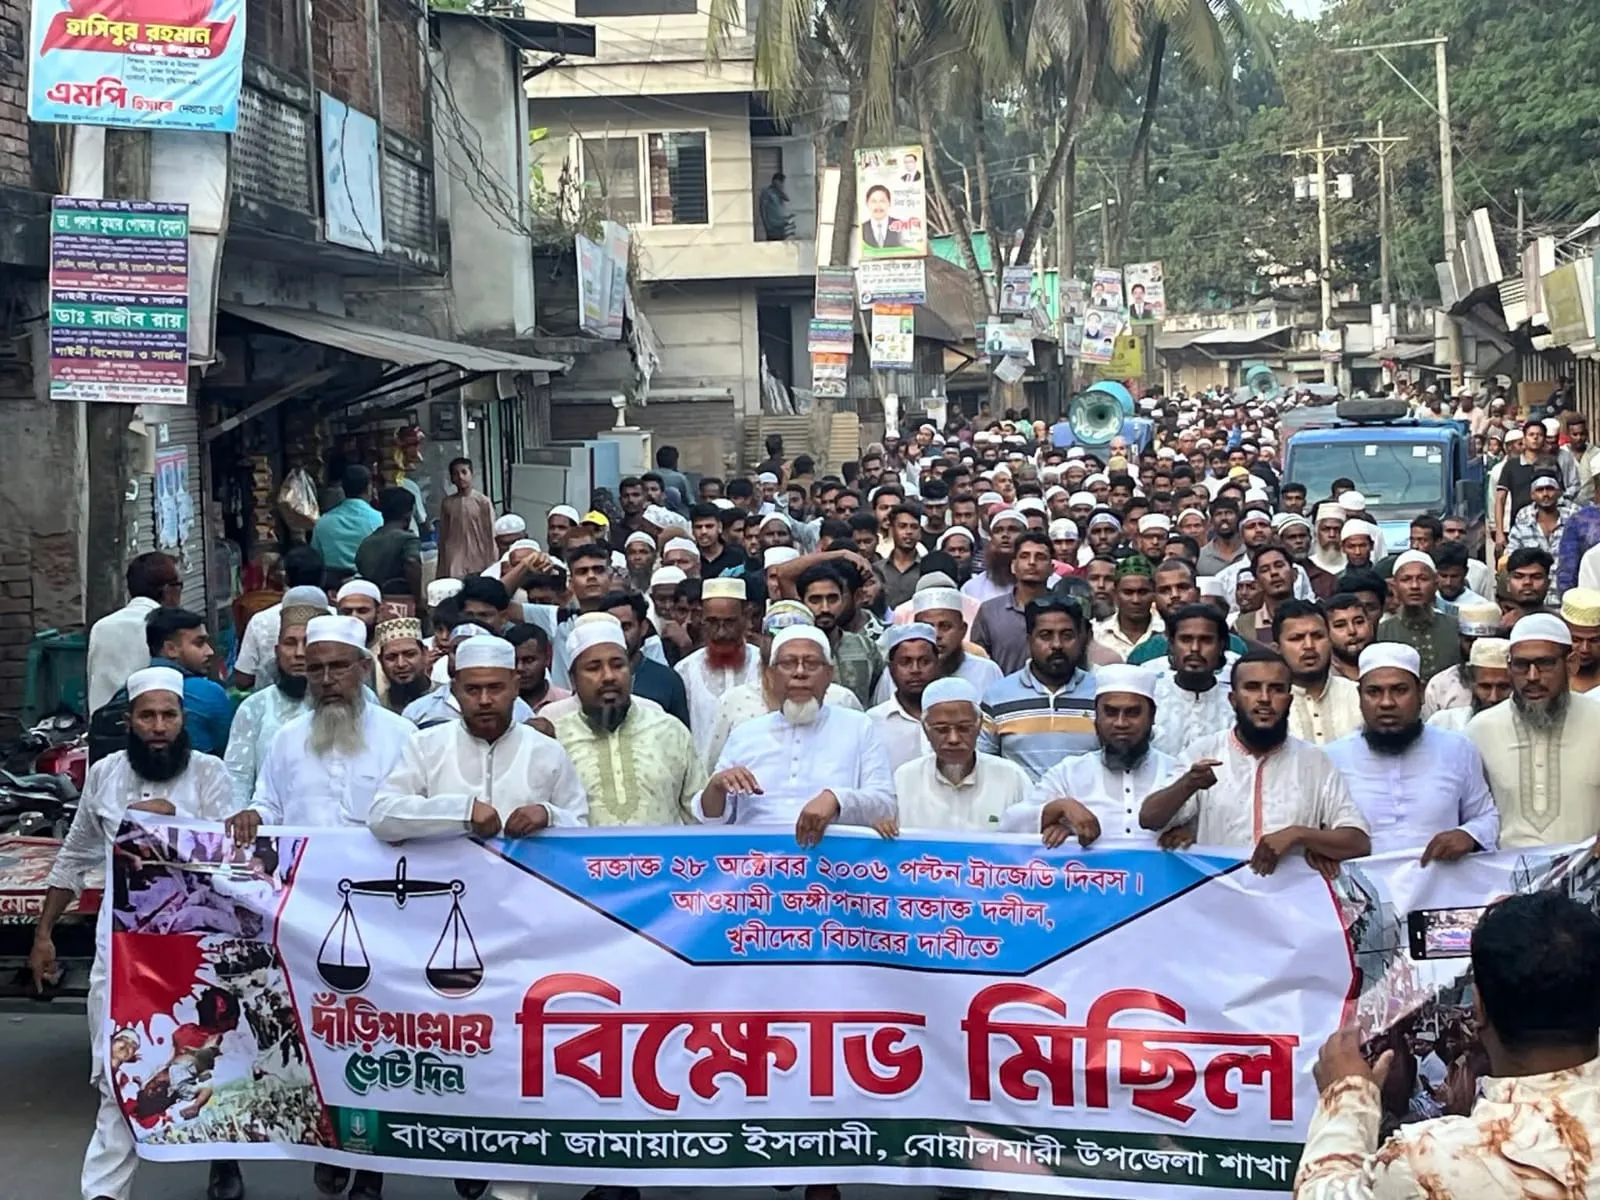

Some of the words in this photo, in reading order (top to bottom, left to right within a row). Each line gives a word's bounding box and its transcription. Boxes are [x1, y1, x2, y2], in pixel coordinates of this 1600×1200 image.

[66, 12, 139, 46] হাসিবুর
[145, 24, 211, 45] রহমান
[46, 75, 128, 109] এমপি
[54, 308, 85, 324] ডাঃ
[90, 306, 146, 327] রাজীব
[150, 311, 184, 329] রায়
[586, 855, 662, 879] রক্তাক্ত
[671, 857, 706, 880] ২৮
[715, 850, 808, 879] অক্টোবর
[817, 857, 888, 881] ২০০৬
[900, 855, 962, 884] পল্টন
[967, 858, 1055, 889] ট্রাজেডি
[672, 884, 774, 914] আওয়ামী
[898, 895, 972, 919] রক্তাক্ত
[981, 892, 1054, 929] দলীল,
[727, 919, 814, 955] খুনীদের
[821, 921, 908, 953] বিচারের
[917, 928, 1004, 959] দাবীতে
[515, 972, 927, 1112] বিক্ষোভ
[961, 982, 1300, 1122] মিছিল
[344, 1048, 412, 1093] ভোট
[415, 1050, 466, 1093] দিন
[387, 1122, 551, 1156] বাংলাদেশ
[560, 1128, 733, 1159] জামায়াতে
[741, 1121, 887, 1161] ইসলামী,
[904, 1130, 1067, 1167] বোয়ালমারী
[1074, 1138, 1208, 1176] উপজেলা
[1216, 1152, 1291, 1182] শাখা
